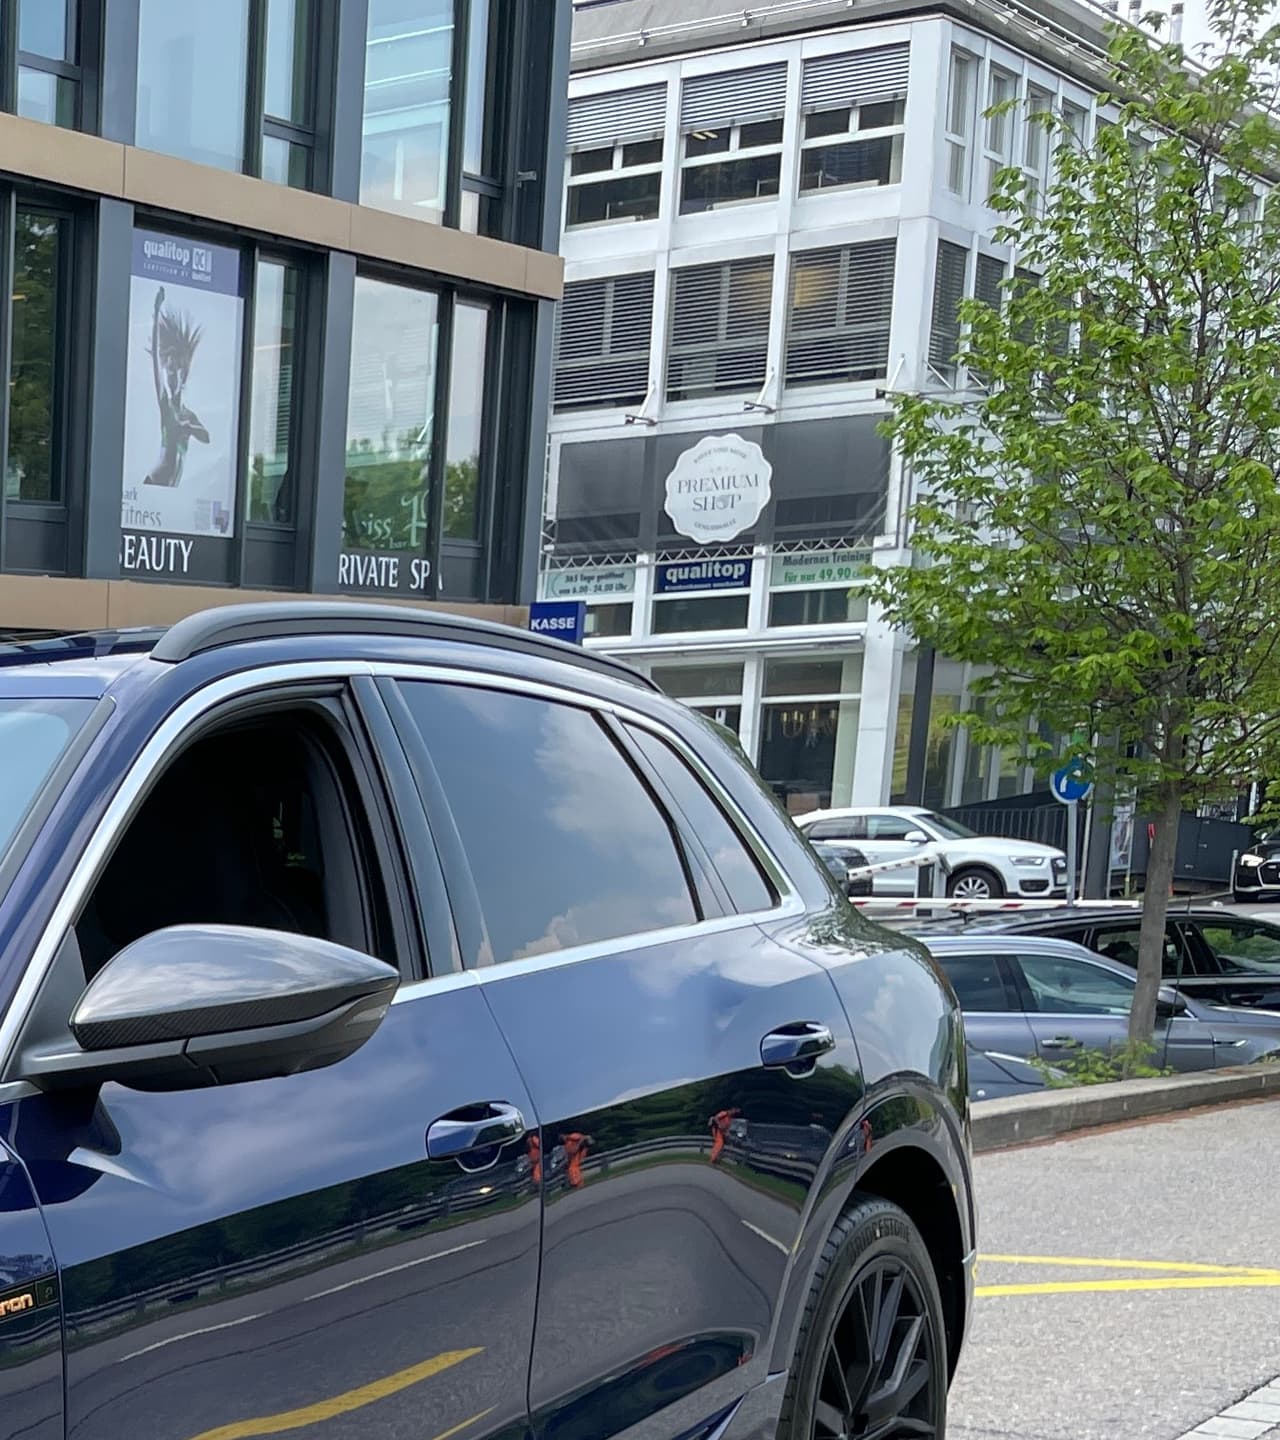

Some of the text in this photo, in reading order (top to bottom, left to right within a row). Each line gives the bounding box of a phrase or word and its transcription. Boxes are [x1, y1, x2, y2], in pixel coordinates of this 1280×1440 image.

[144, 240, 190, 266] qualitop
[677, 473, 758, 493] PREMIUM
[692, 494, 742, 511] SHOP
[119, 534, 193, 573] EAUTY
[783, 551, 872, 566] Modernes Training
[409, 558, 443, 590] SP
[665, 562, 745, 583] qualitop
[530, 617, 575, 630] KASSE
